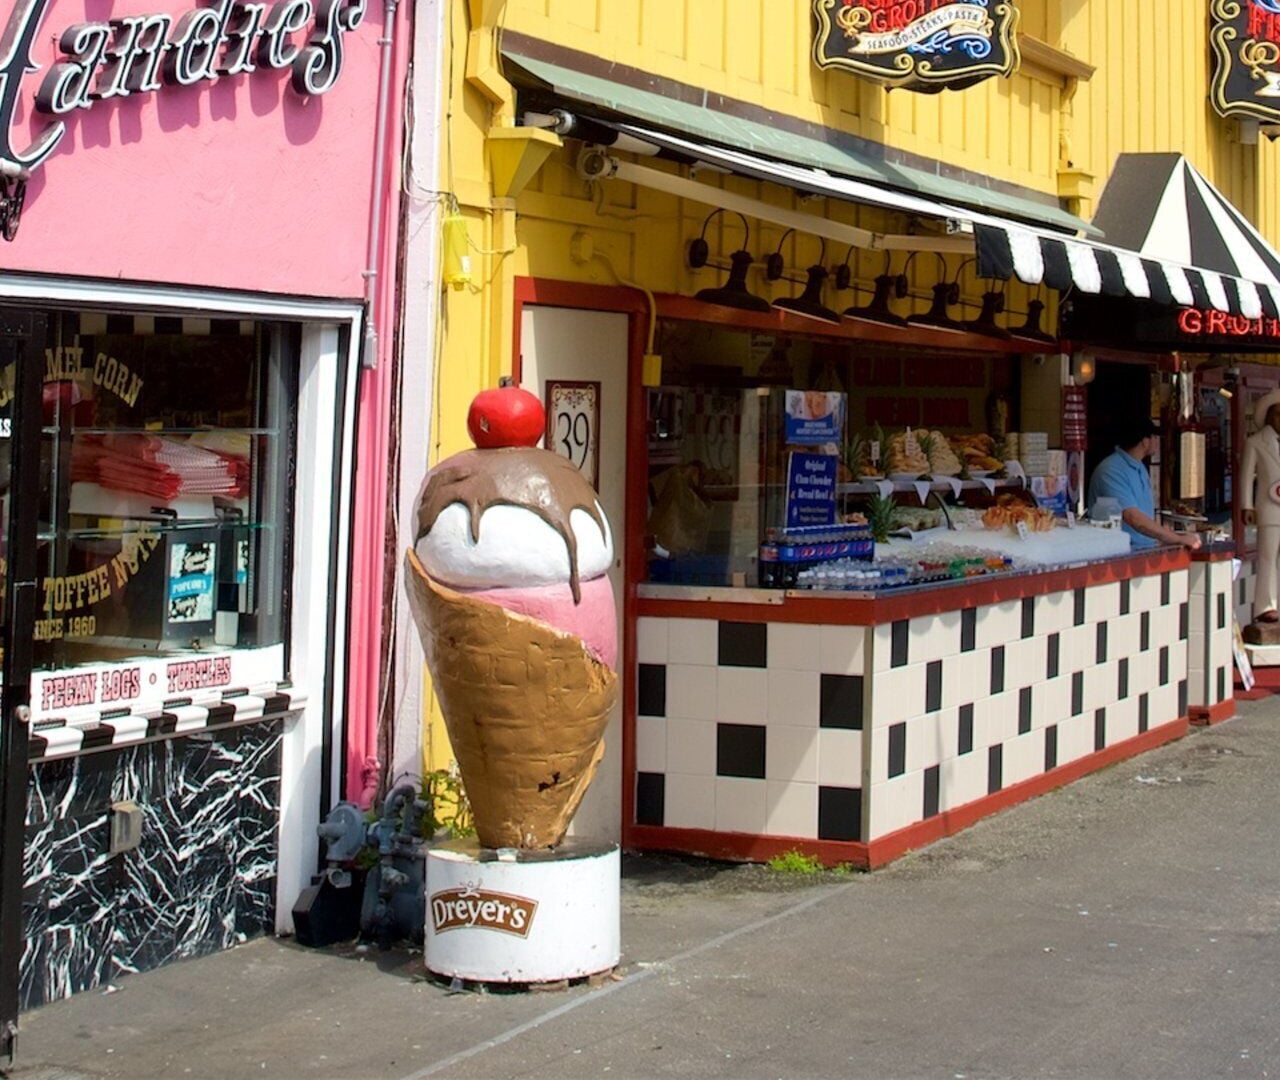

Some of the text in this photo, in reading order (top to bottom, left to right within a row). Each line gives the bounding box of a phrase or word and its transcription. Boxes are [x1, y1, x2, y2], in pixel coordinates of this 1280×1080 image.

[92, 352, 144, 408] CORN
[558, 412, 589, 471] 39
[41, 564, 112, 613] TOFFEE
[111, 524, 161, 590] NUTS
[68, 615, 96, 636] 1960
[41, 655, 232, 710] PECAN LOGS TURTLES
[433, 897, 528, 929] Dreyer's
